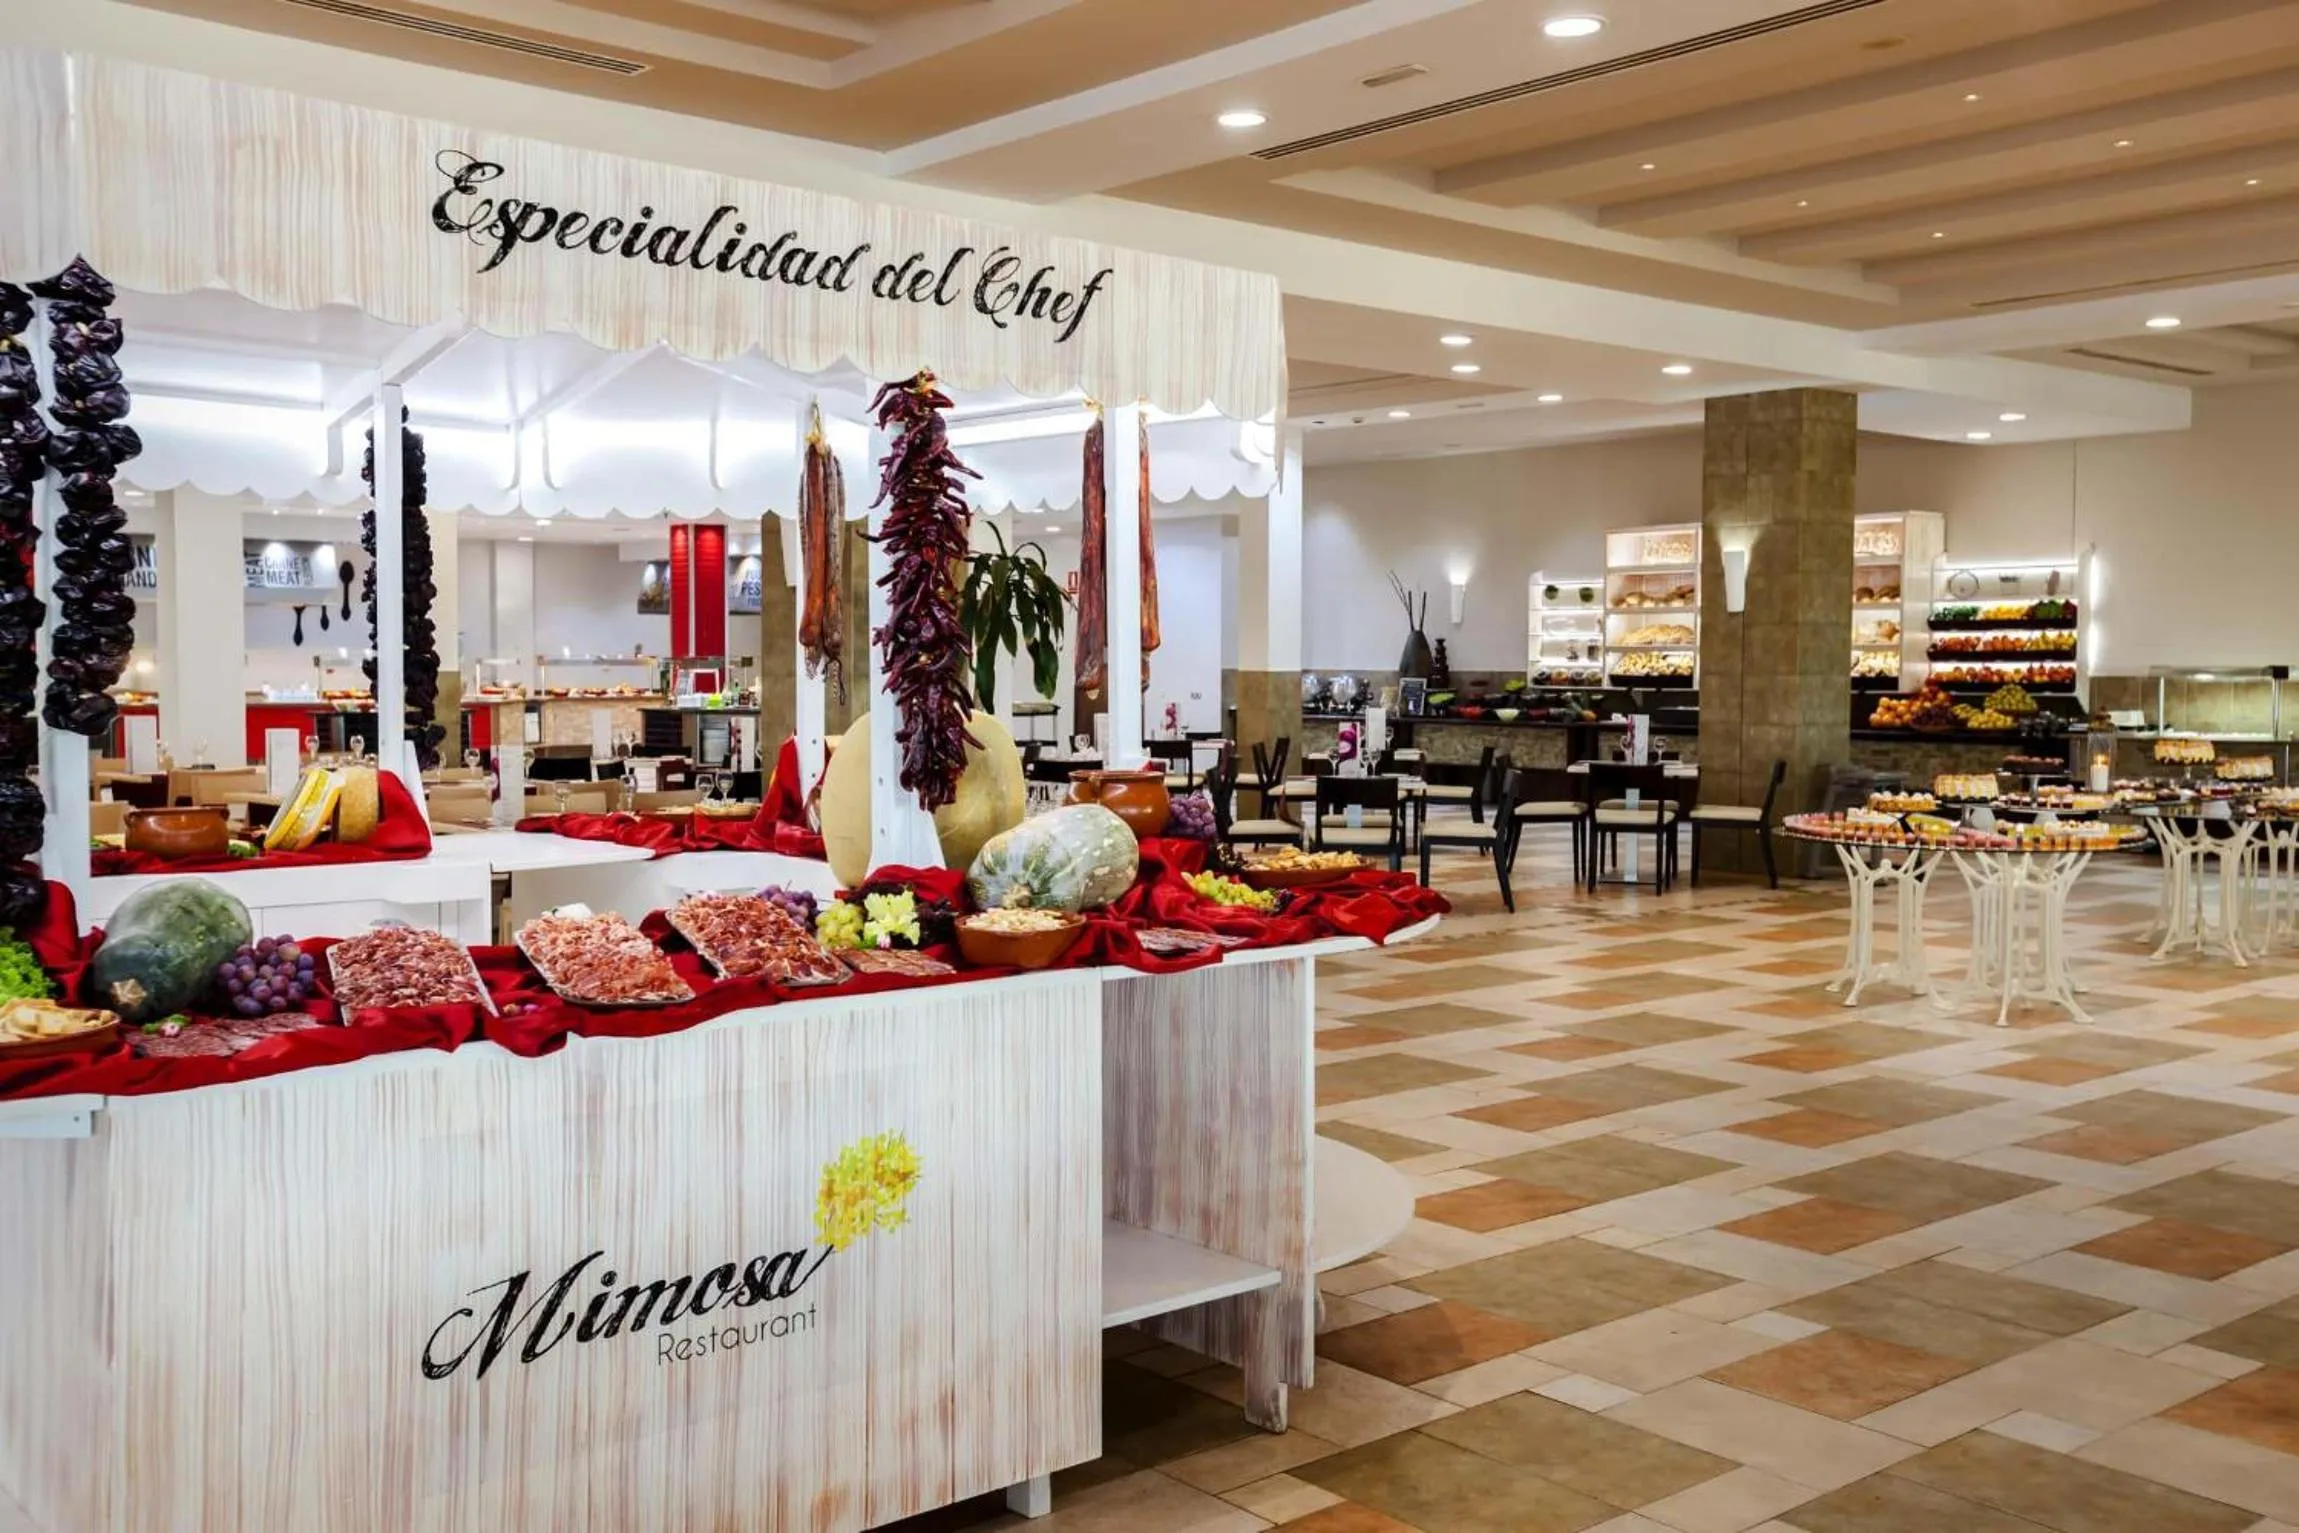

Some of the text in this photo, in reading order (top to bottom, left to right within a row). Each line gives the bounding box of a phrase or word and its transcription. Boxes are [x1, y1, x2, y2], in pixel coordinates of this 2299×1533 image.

[432, 149, 1114, 343] Especialidad del Chef
[265, 570, 301, 585] MEAT
[421, 1244, 833, 1381] Mimosa
[656, 1302, 818, 1367] Restaurant
